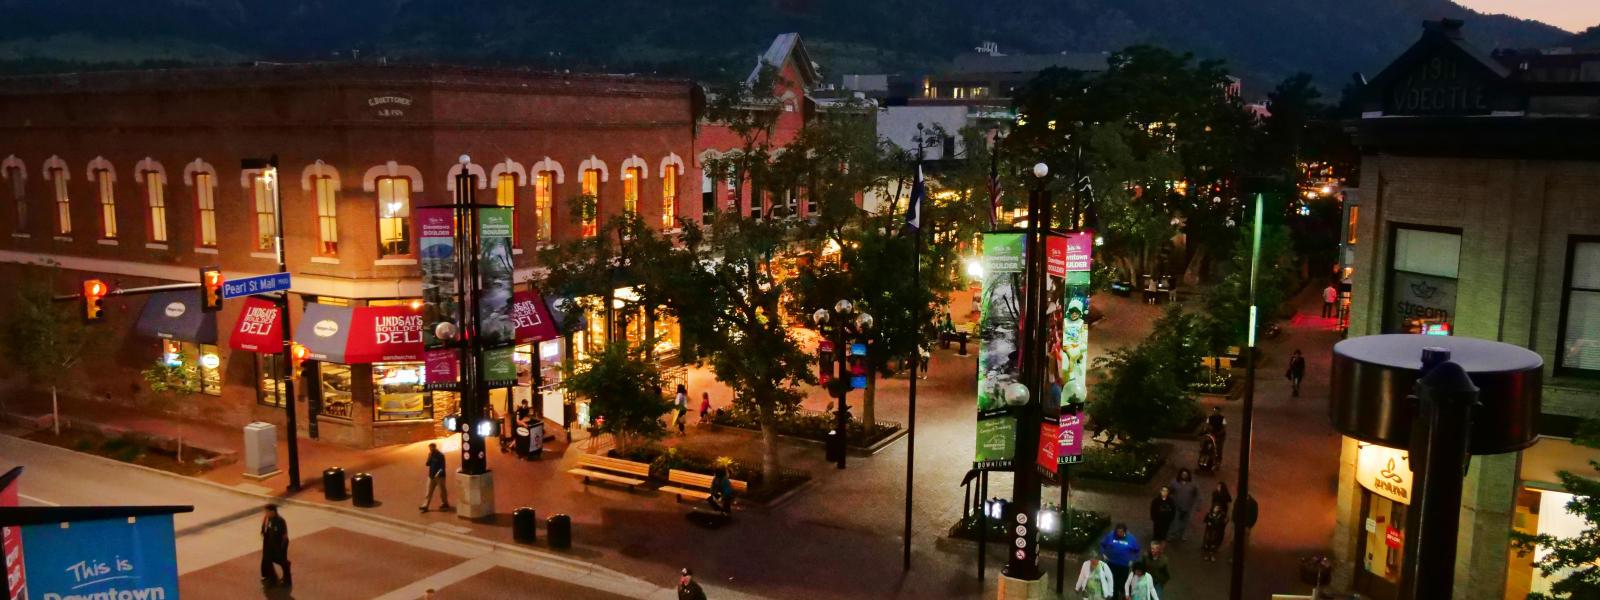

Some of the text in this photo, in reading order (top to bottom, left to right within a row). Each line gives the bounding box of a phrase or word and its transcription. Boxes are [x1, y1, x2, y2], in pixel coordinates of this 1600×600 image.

[225, 282, 247, 296] Pearl
[249, 279, 258, 292] St
[260, 277, 276, 290] Mall
[247, 306, 278, 319] LINDSAY'S
[1398, 300, 1448, 322] stream
[375, 315, 423, 327] LINDSAY'S
[240, 321, 272, 335] DELI
[375, 325, 423, 333] BOULDER
[375, 331, 423, 344] DELI
[977, 461, 1012, 469] DOWNTOWN
[1057, 455, 1077, 463] ULDER
[65, 555, 133, 582] This is
